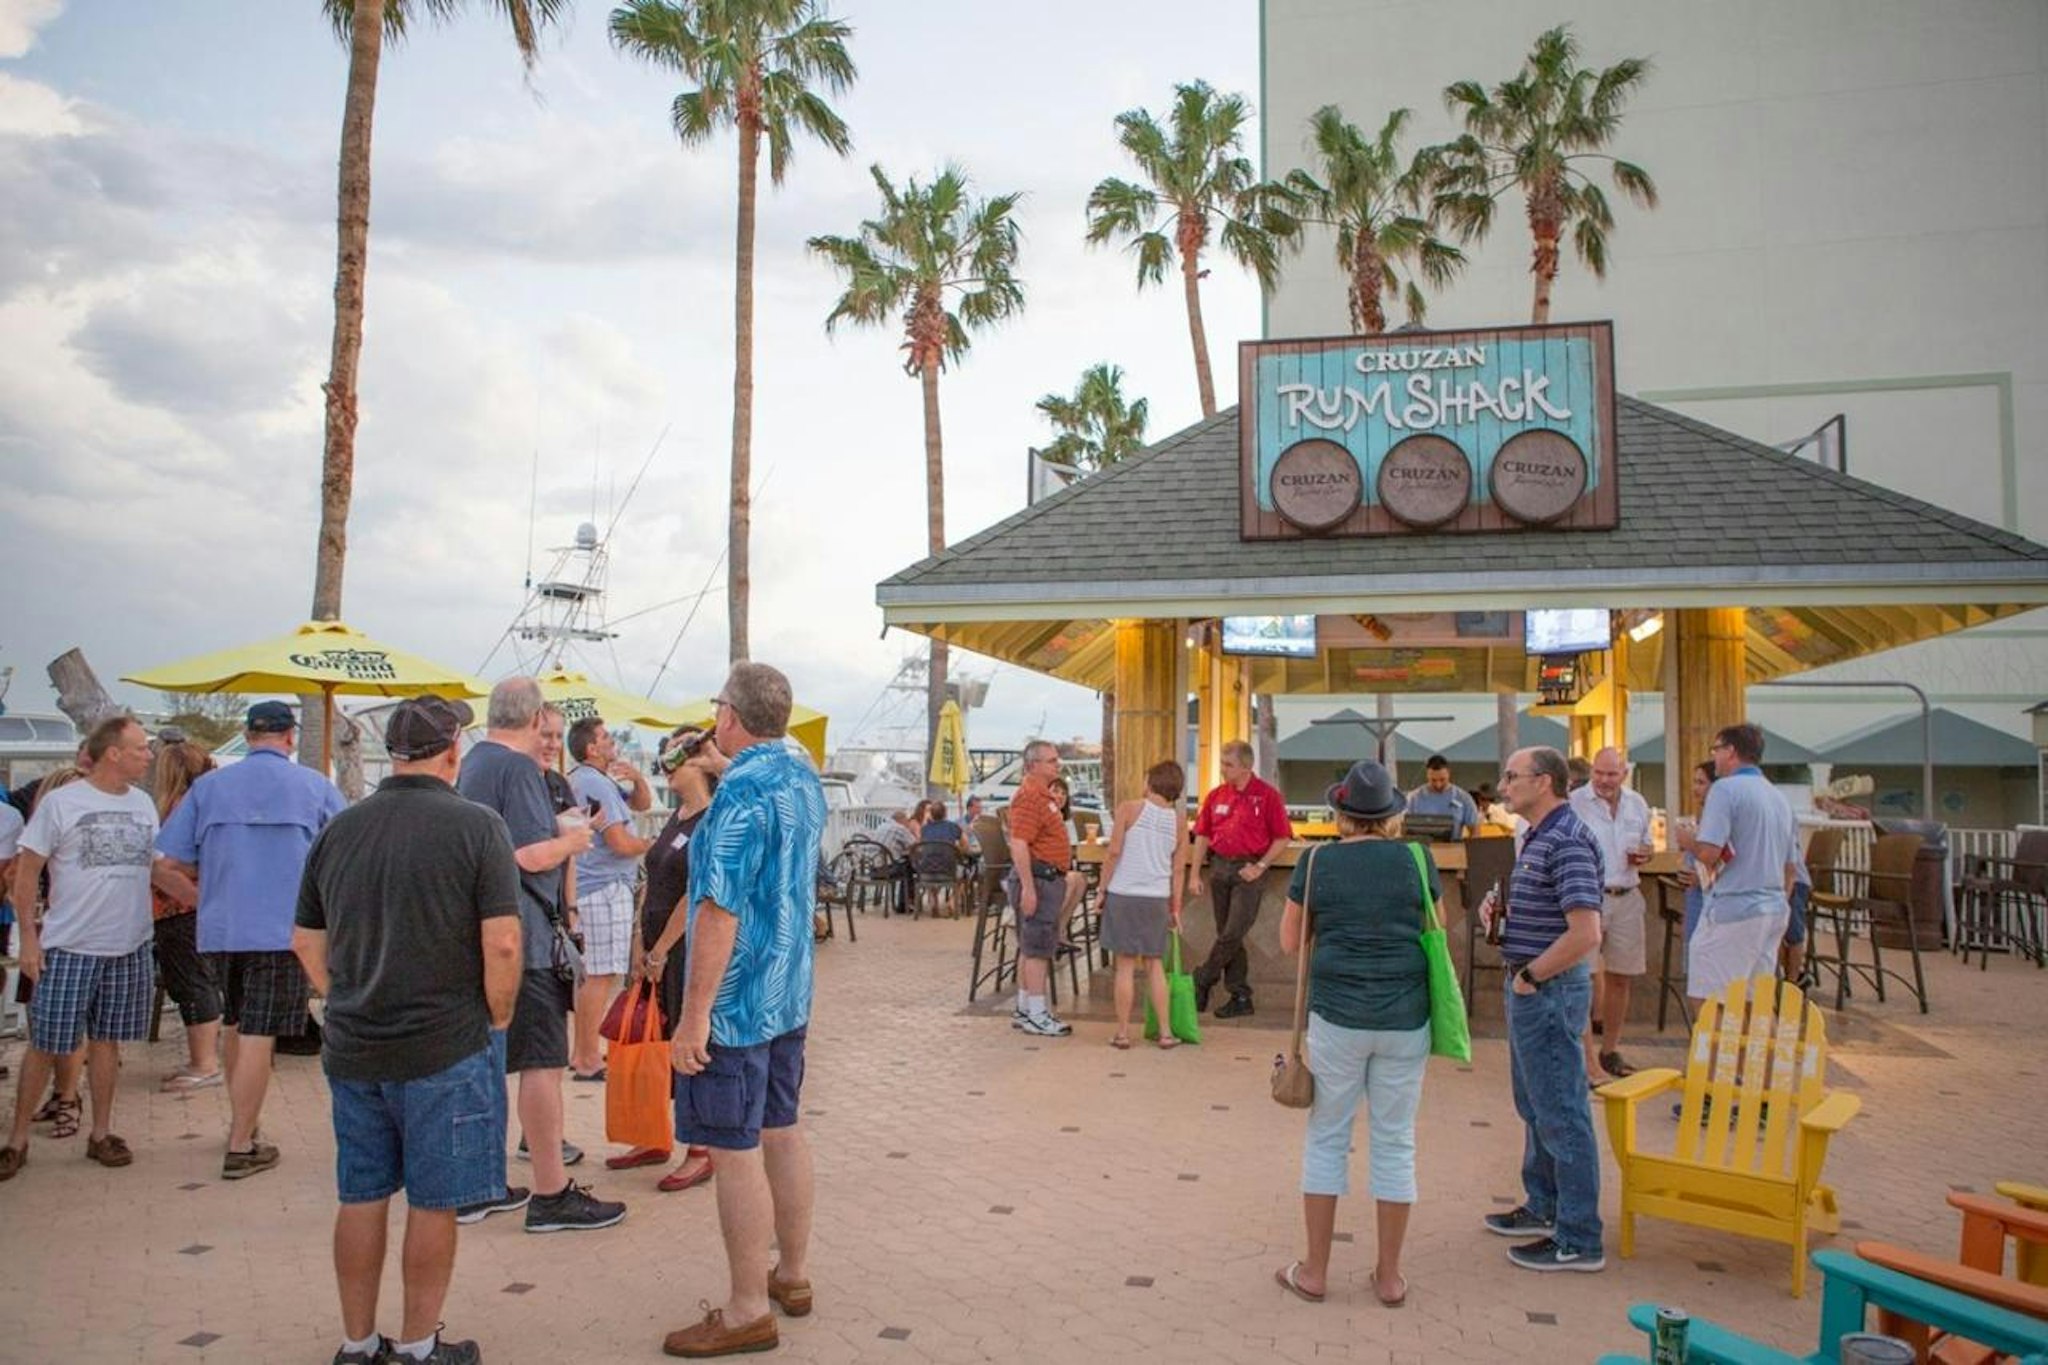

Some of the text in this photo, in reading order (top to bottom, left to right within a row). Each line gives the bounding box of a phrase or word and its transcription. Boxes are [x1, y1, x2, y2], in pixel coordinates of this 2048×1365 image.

[1355, 345, 1486, 373] CRUZAN
[1277, 368, 1573, 432] RUM SHACK
[1388, 466, 1461, 480] CRUZAN
[1502, 461, 1576, 477] CRUZAN
[1280, 472, 1350, 486] CRUZAN
[289, 653, 394, 672] Corona
